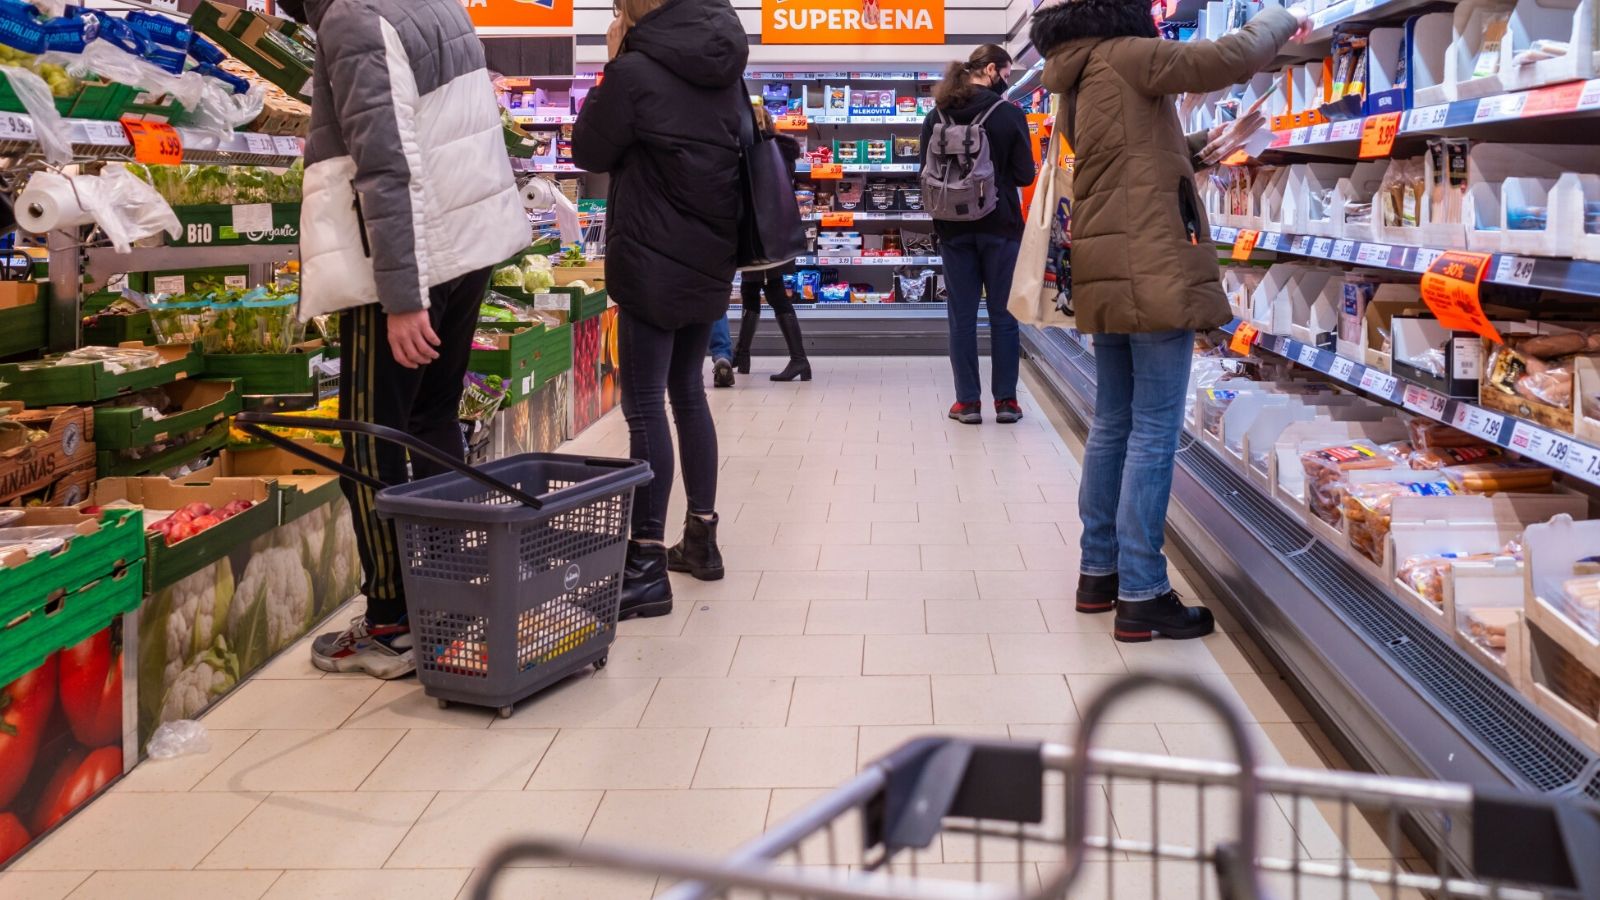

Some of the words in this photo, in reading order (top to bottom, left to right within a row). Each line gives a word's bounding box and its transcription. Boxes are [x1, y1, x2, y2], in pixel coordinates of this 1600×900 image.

[773, 8, 934, 30] SUPERCENA
[1377, 124, 1395, 146] 3.99
[1514, 261, 1533, 279] 2.49
[1482, 417, 1500, 437] 7.99
[1546, 439, 1568, 460] 7.99
